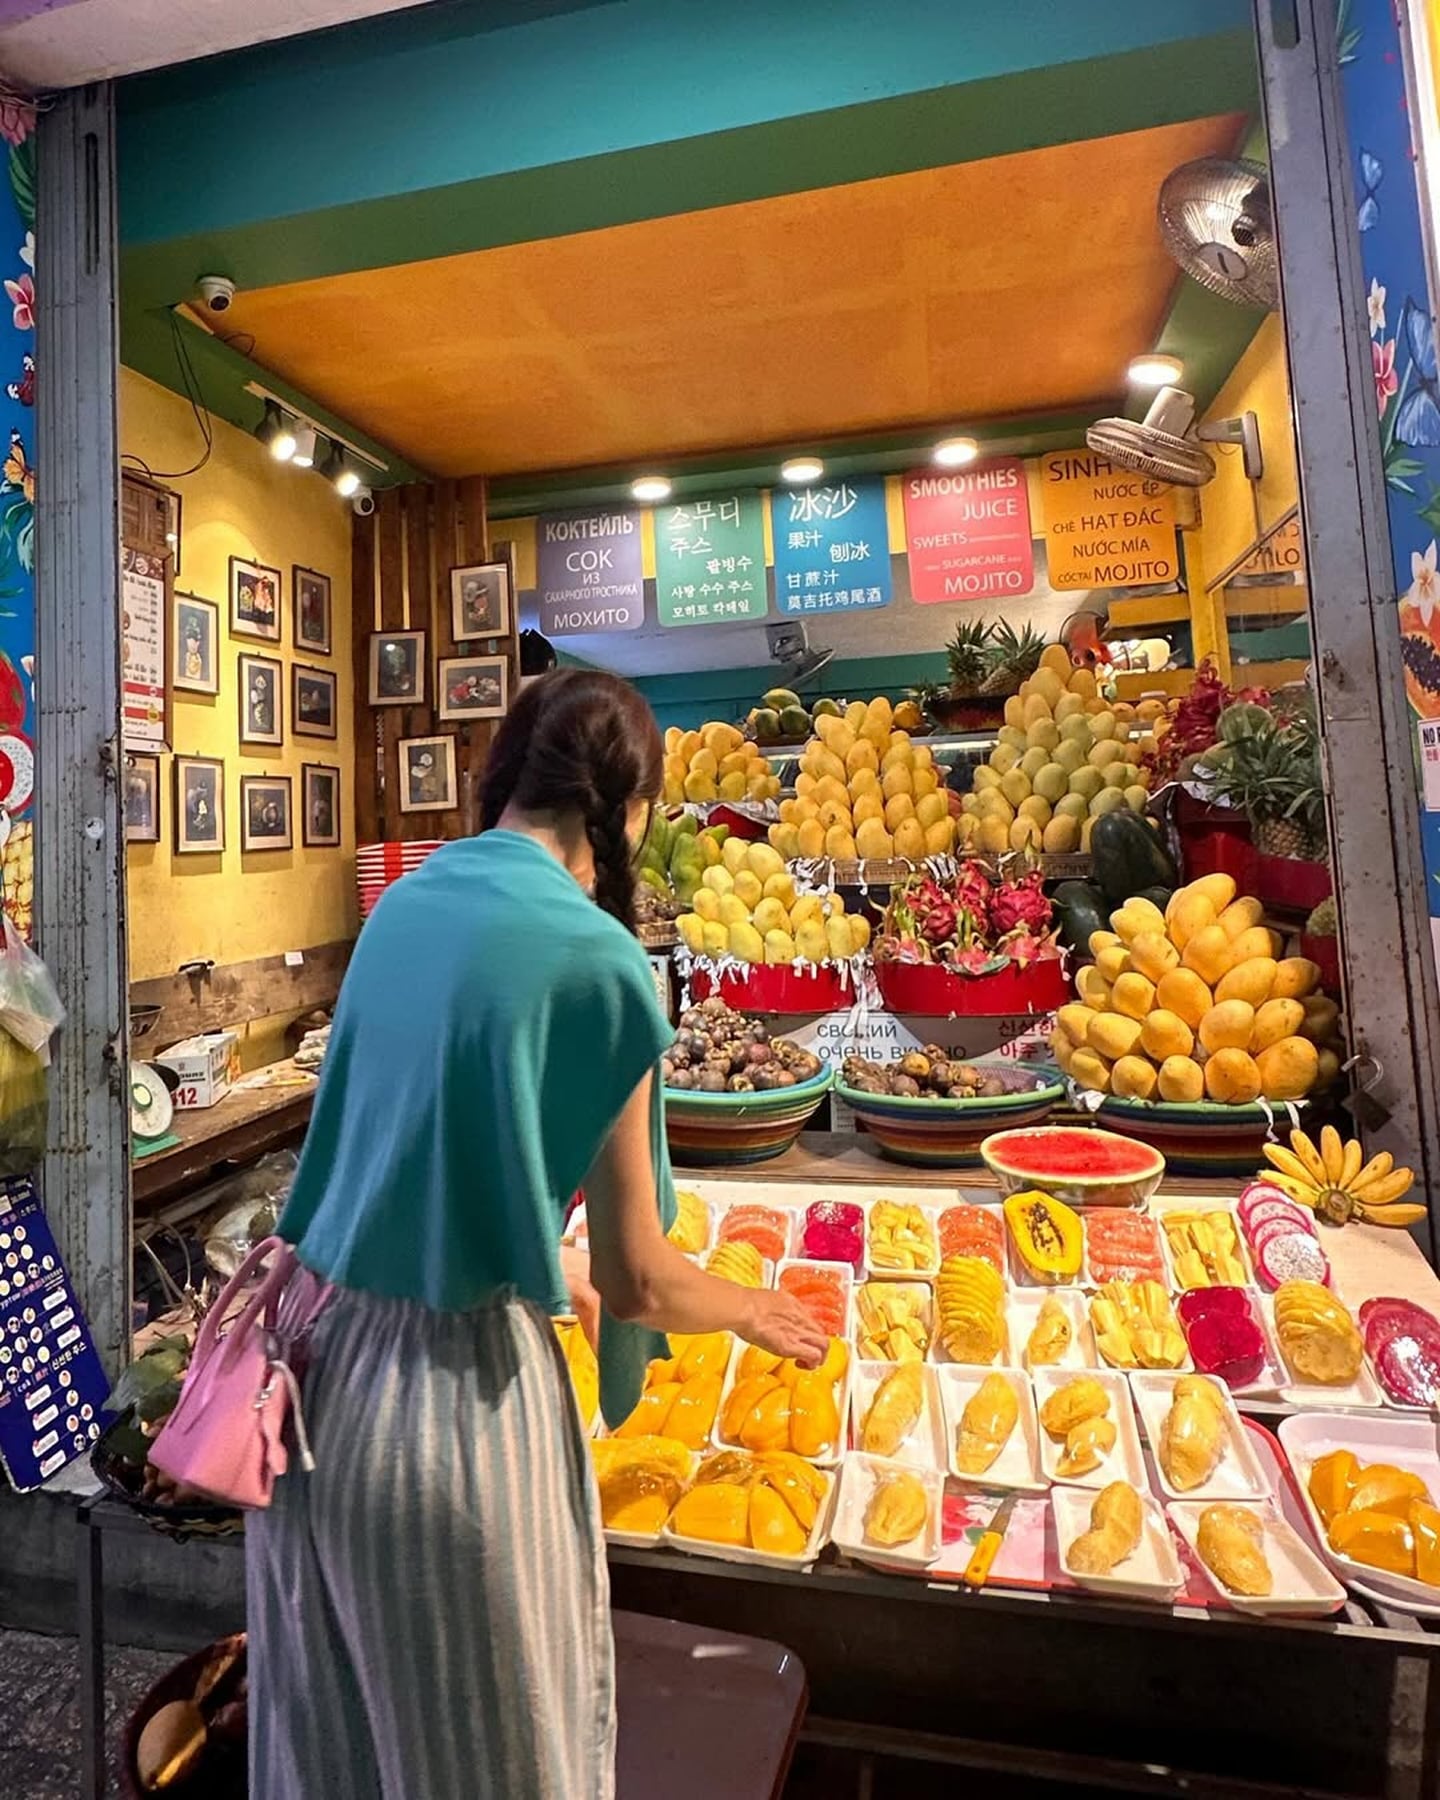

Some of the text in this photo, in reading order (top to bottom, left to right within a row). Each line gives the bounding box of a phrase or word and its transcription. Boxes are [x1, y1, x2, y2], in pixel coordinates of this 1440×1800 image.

[1049, 457, 1113, 482] SINH
[910, 468, 1018, 499] SMOOTHIES
[667, 496, 740, 532] 스무디
[789, 484, 858, 522] 冰沙
[963, 498, 1019, 521] JUICE
[546, 513, 634, 542] КОКТЕЙЛЬ
[1081, 513, 1119, 533] HẠT
[1123, 507, 1163, 527] ĐÁC
[670, 536, 713, 560] 주스
[788, 530, 823, 549] 果汁
[913, 532, 968, 549] SWEETS
[1073, 536, 1151, 558] NƯỚC MÍA
[566, 548, 614, 572] СОК
[829, 541, 870, 563] 刨冰
[942, 554, 1007, 570] SUGARCANE
[583, 572, 601, 585] ИЗ
[787, 568, 840, 589] 甘蔗汁
[945, 570, 1023, 594] MOJITO
[1094, 560, 1169, 583] MOJITO
[699, 582, 725, 597] 수수
[728, 580, 754, 594] 주스
[788, 587, 882, 611] 莫吉托鸡尾酒
[554, 608, 630, 629] МОХИТО
[1423, 727, 1435, 744] NO
[1001, 1042, 1039, 1059] 아주
